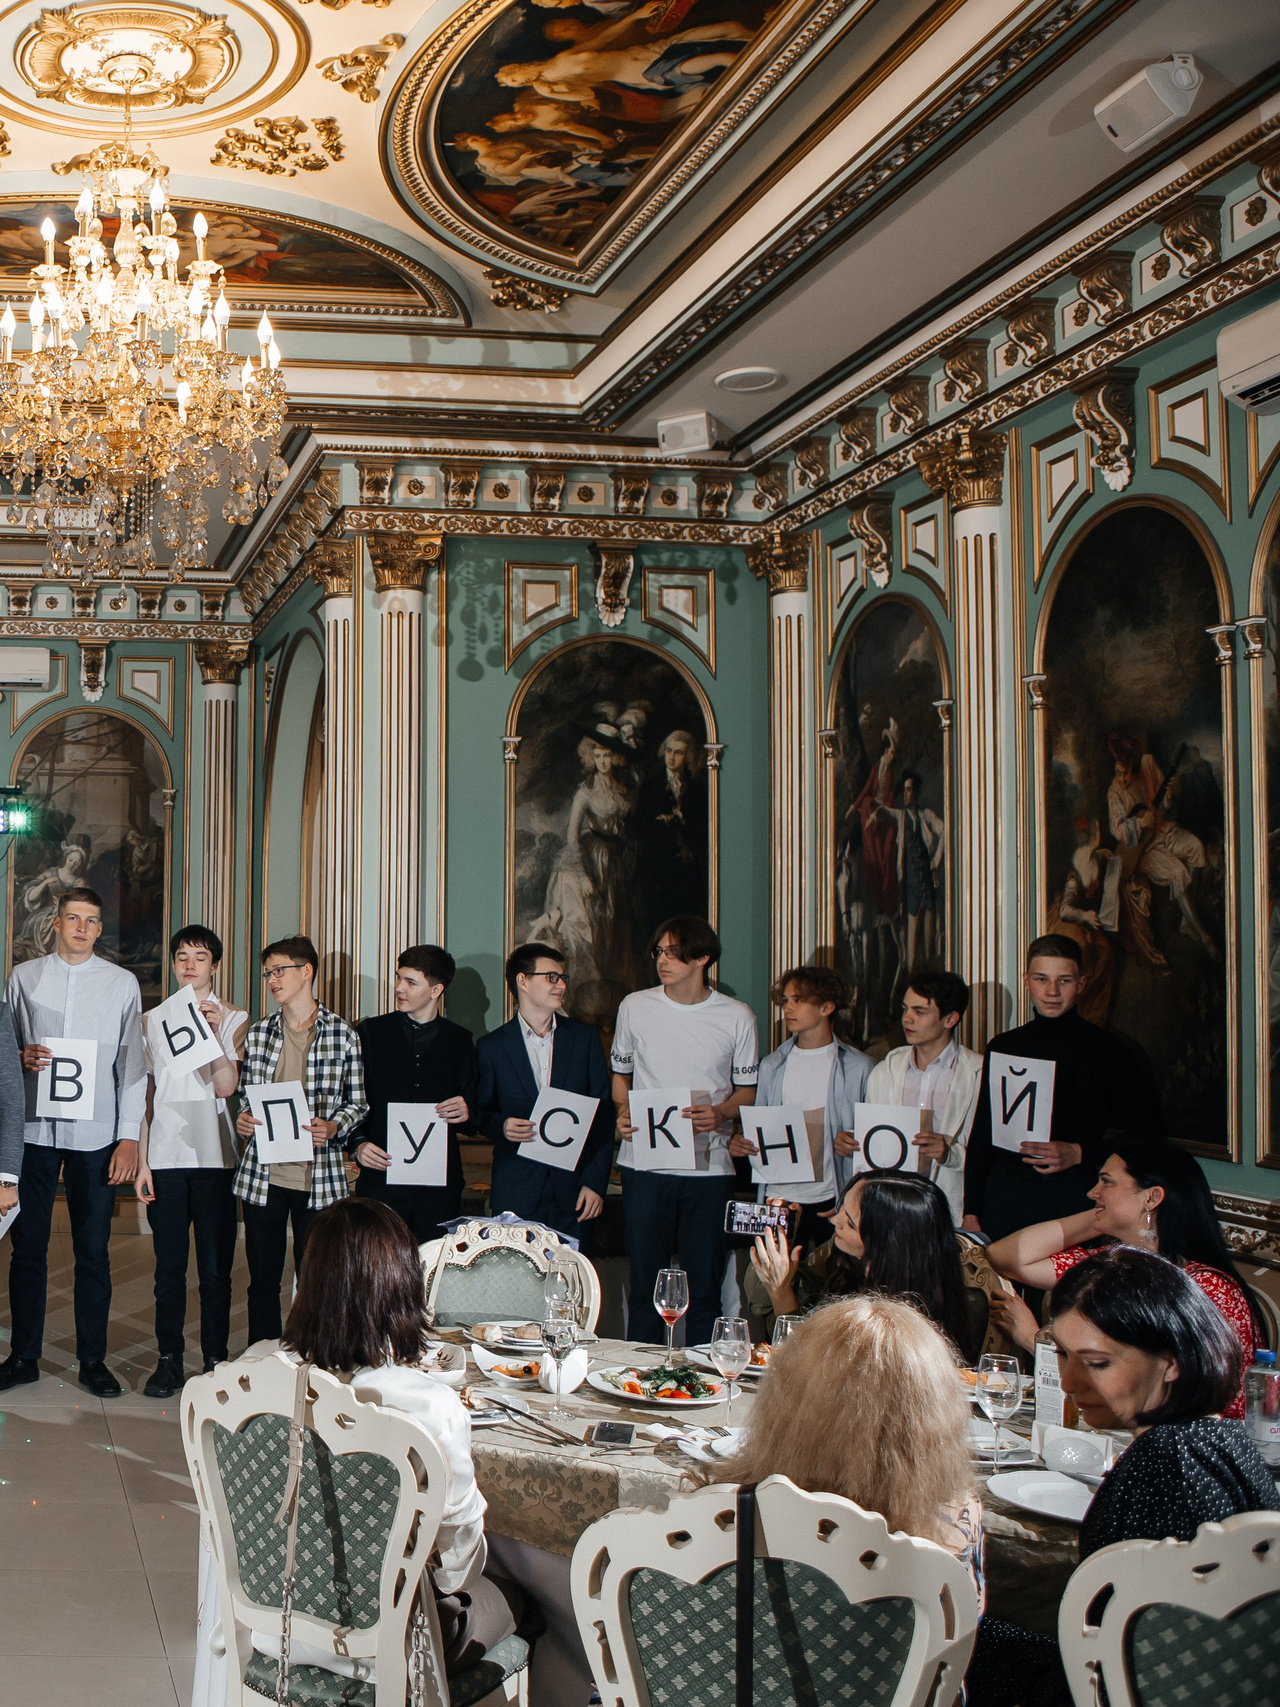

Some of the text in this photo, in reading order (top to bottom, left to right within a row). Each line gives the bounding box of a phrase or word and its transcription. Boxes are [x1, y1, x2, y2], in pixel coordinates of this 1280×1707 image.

[161, 1002, 209, 1058] Ы
[49, 1056, 83, 1103] В
[1000, 1065, 1038, 1132] Й
[261, 1098, 300, 1142] П
[538, 1107, 577, 1148] С
[647, 1105, 681, 1149] К
[399, 1121, 436, 1164] У
[756, 1124, 799, 1167] Н
[863, 1124, 908, 1170] О
